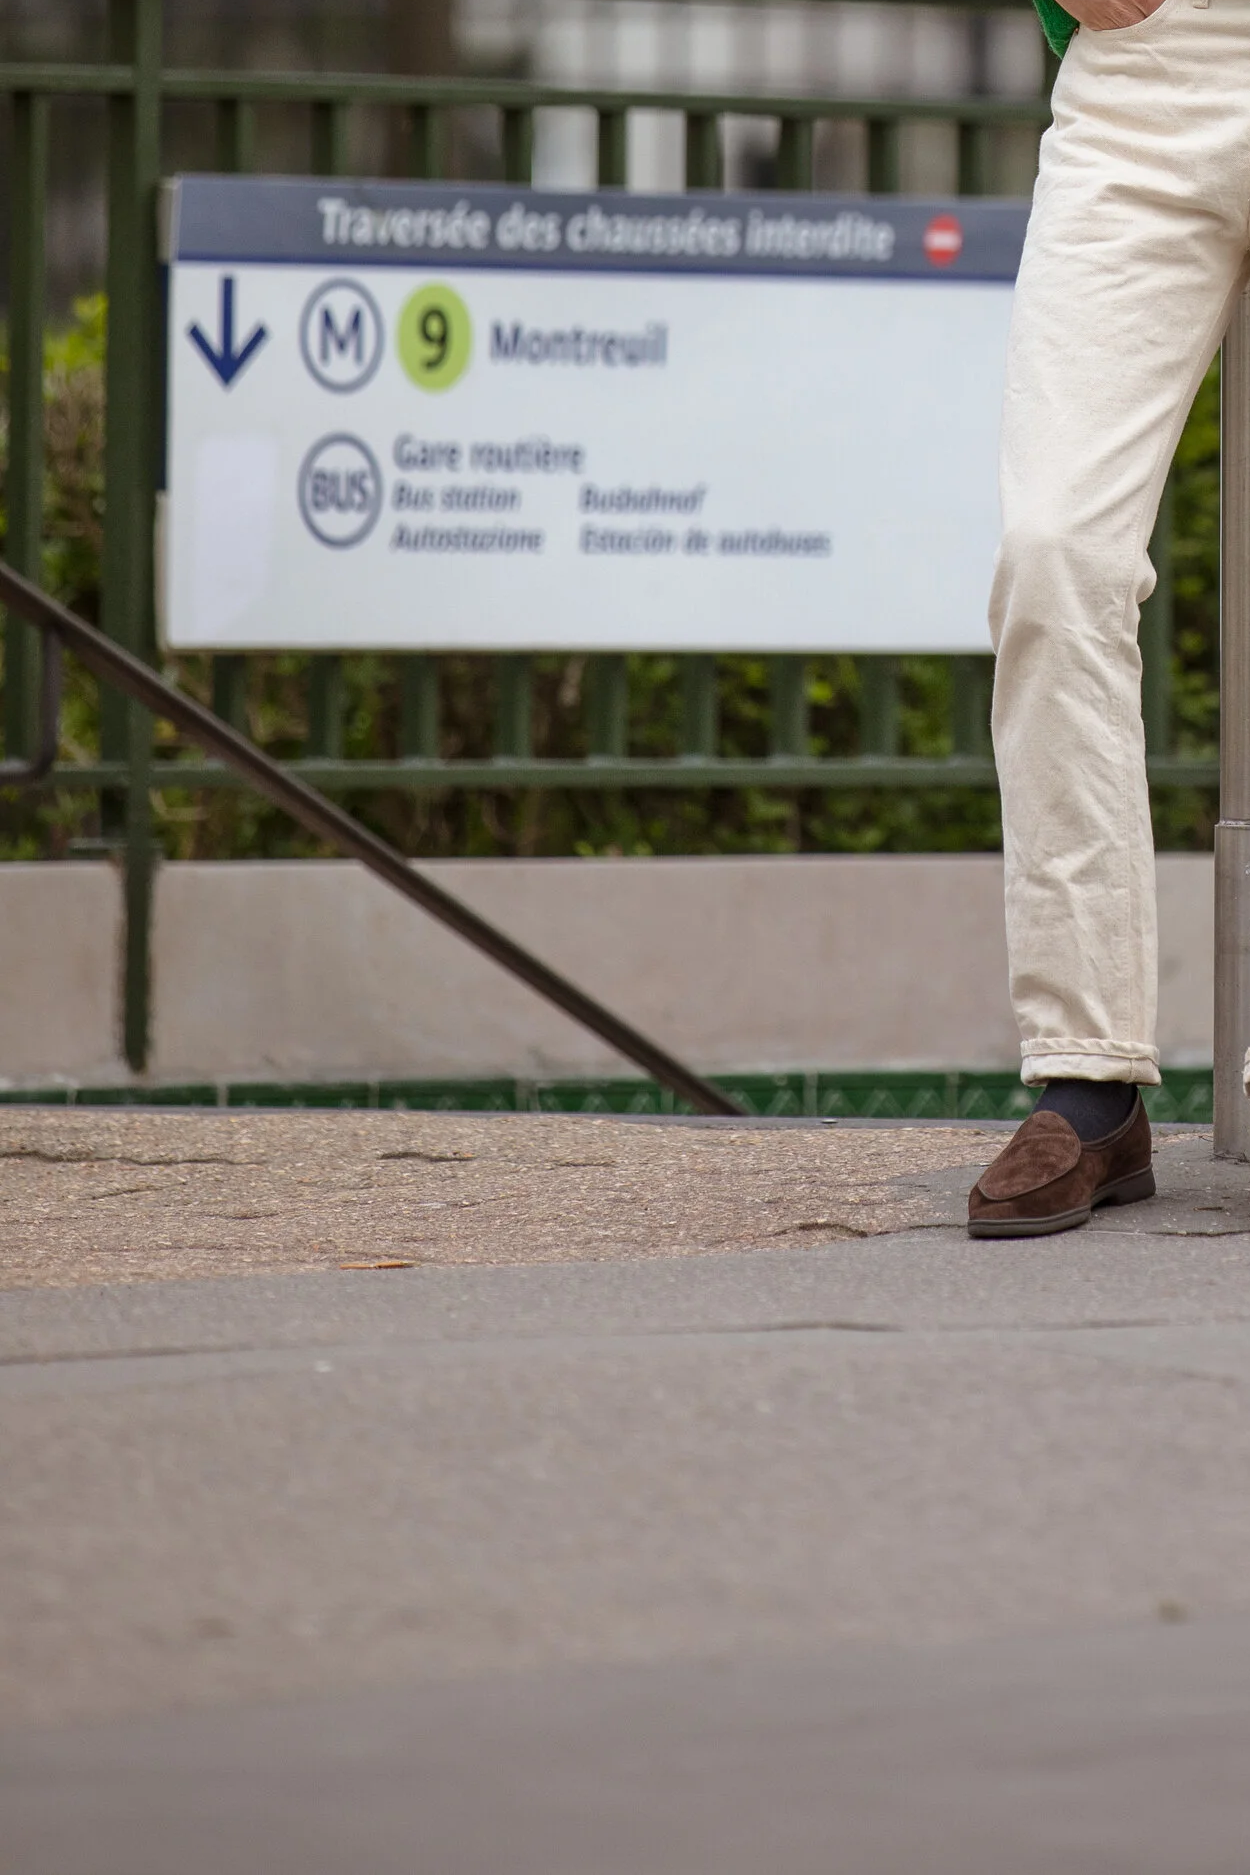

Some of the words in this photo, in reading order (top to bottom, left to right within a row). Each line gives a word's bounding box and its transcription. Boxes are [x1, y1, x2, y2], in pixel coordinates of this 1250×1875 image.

[317, 197, 492, 249] Traversée
[495, 202, 562, 251] des
[565, 204, 742, 256] chaussées
[745, 208, 895, 261] interdite
[320, 304, 365, 367] M
[417, 304, 451, 373] 9
[489, 321, 668, 367] Montreuil
[394, 434, 461, 472] Gare
[470, 434, 585, 474] routière
[311, 468, 370, 513] BUS
[391, 480, 434, 511] Bus
[441, 483, 522, 512] station
